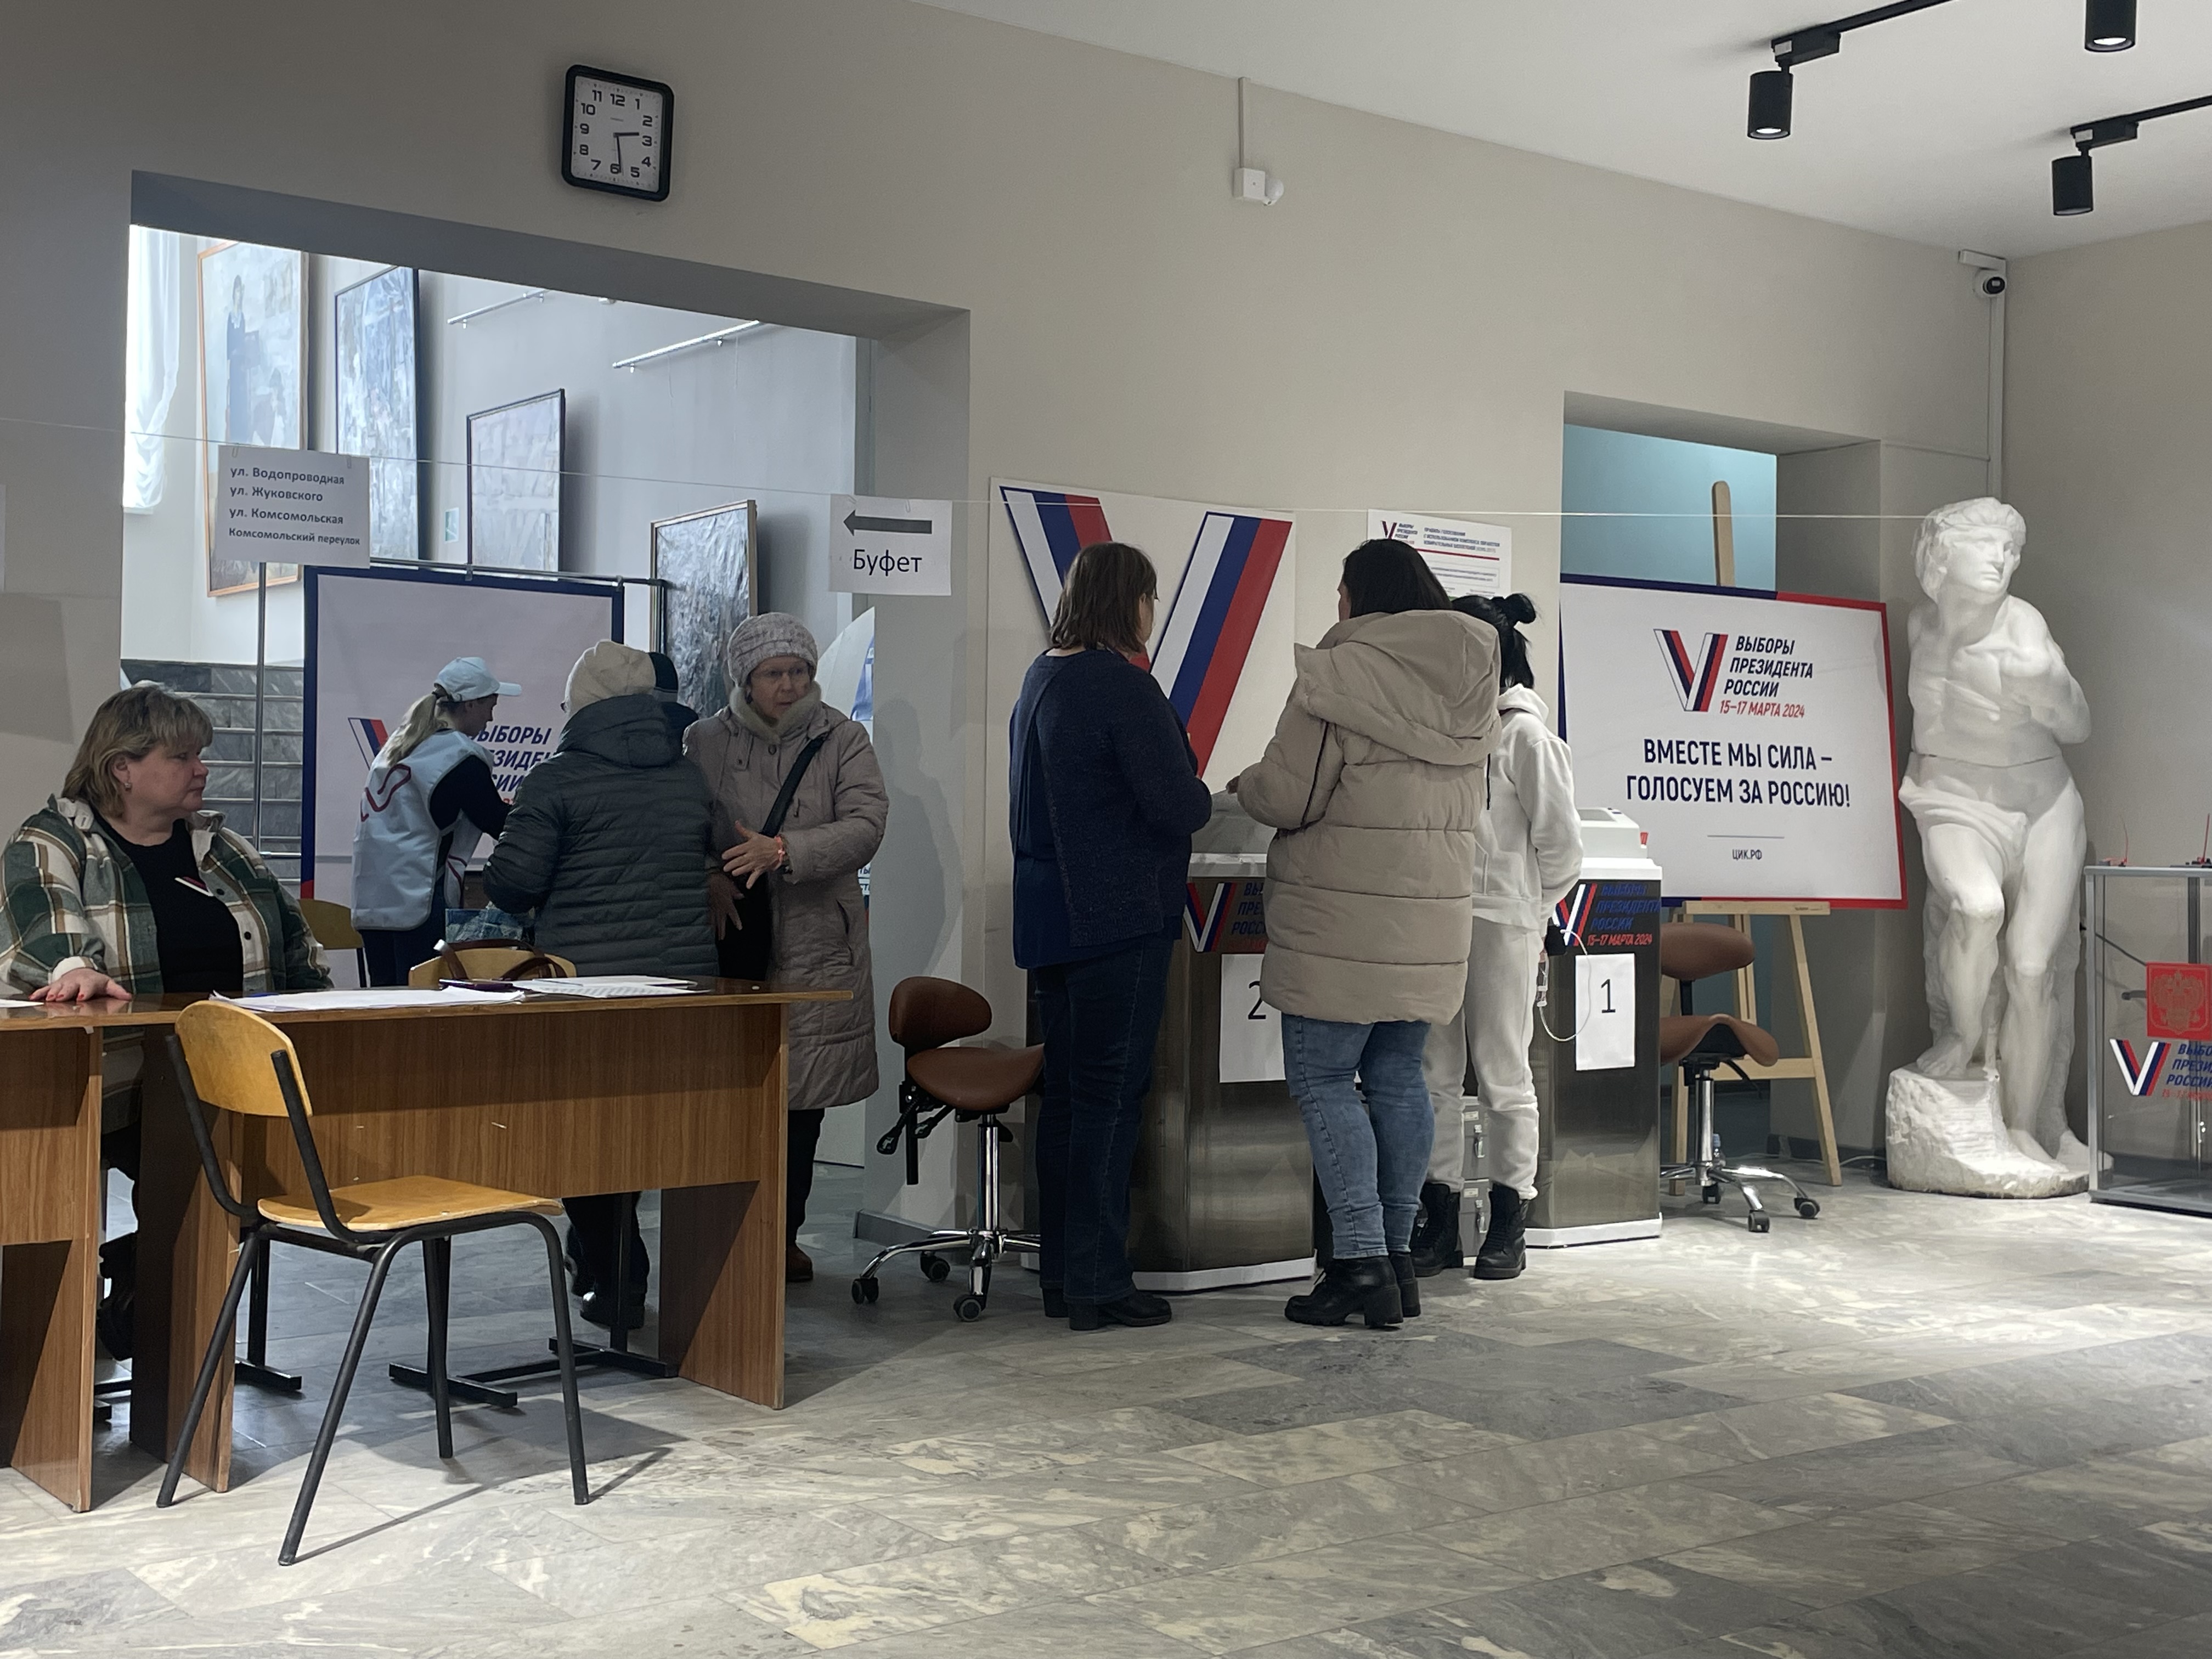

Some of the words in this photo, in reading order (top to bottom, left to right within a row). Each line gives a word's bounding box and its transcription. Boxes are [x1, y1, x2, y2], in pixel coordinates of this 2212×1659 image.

[592, 90, 602, 102] 11
[610, 93, 625, 107] 12
[581, 103, 595, 115] 10
[634, 98, 641, 110] 1
[642, 115, 652, 127] 2
[580, 123, 589, 134] 9
[642, 136, 652, 146] 3
[579, 144, 589, 155] 8
[591, 160, 601, 170] 7
[611, 163, 620, 174] 6
[642, 157, 651, 167] 4
[630, 167, 640, 178] 5
[230, 467, 249, 478] ул.
[252, 467, 345, 485] Водопроводная
[230, 487, 248, 497] ул.
[252, 487, 323, 501] Жуковского
[229, 508, 248, 518] ул.
[251, 509, 343, 524] Комсомольская
[229, 528, 315, 542] Комсомольский
[318, 535, 360, 545] переулок
[854, 549, 922, 577] Буфет
[1735, 635, 1795, 654] ВЫБОРЫ
[1730, 657, 1813, 678] ПРЕЗИДЕНТА
[1724, 679, 1779, 697] РОССИИ
[1748, 702, 1780, 716] МАРТА
[1782, 703, 1805, 718] 2024
[472, 725, 552, 744] ЫБОРЫ
[1644, 738, 1722, 766] ВМЕСТЕ
[1728, 742, 1762, 768] МЫ
[1768, 744, 1816, 770] СИЛА
[1626, 775, 1733, 803] ГОЛОСУЕМ
[1739, 779, 1763, 804] ЗА
[1768, 781, 1850, 807] РОССИЮ!
[1732, 849, 1763, 861] ЦИК.РФ
[1244, 882, 1264, 896] ВЫ
[1237, 901, 1264, 915] ПРЕ
[1231, 922, 1266, 935] РОСС
[1590, 917, 1634, 930] РОССИИ
[1608, 934, 1633, 945] МАРТА
[1248, 980, 1266, 1020] 2
[1600, 979, 1616, 1013] 1
[2178, 1043, 2211, 1056] ВЫБО
[2172, 1059, 2211, 1073] ПРЕЗИ
